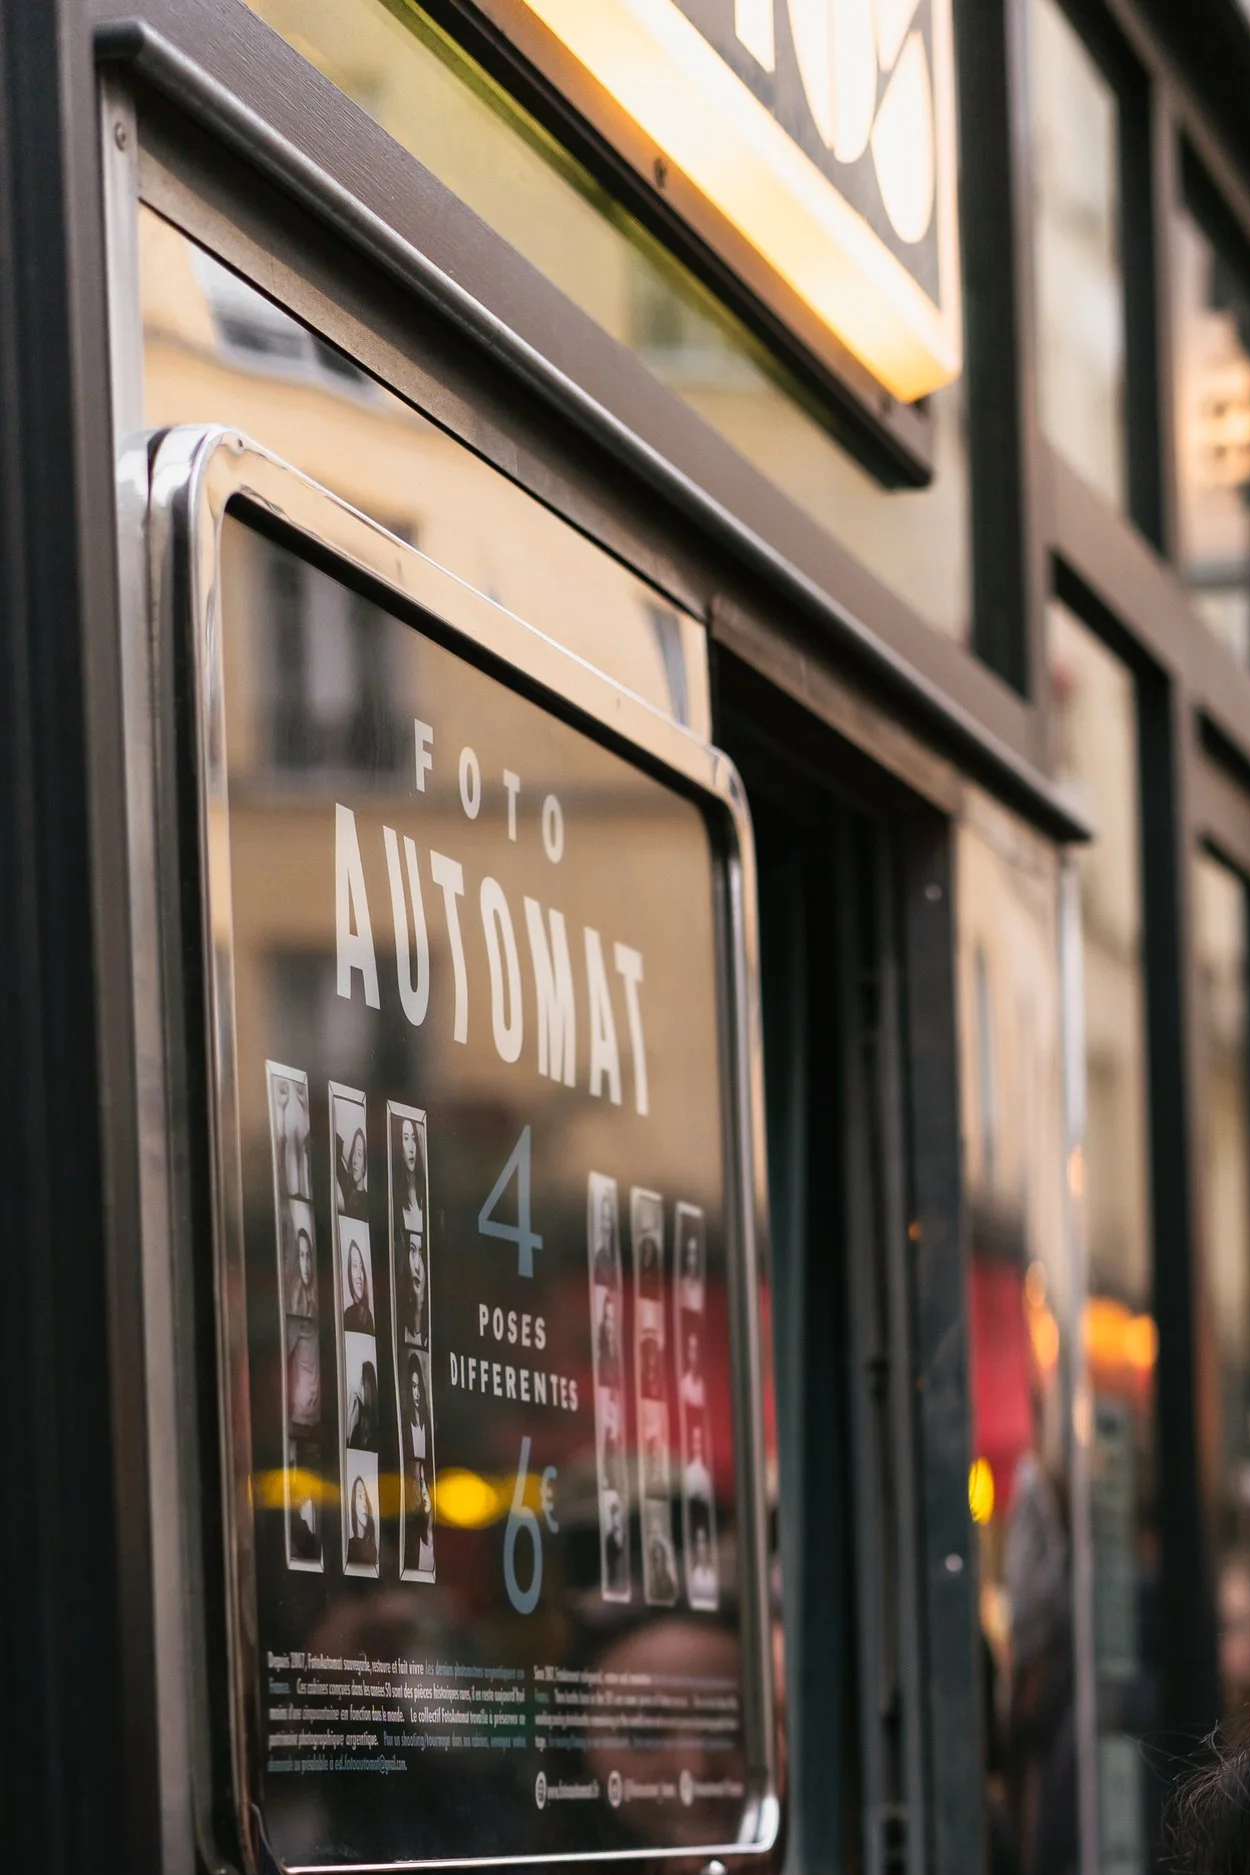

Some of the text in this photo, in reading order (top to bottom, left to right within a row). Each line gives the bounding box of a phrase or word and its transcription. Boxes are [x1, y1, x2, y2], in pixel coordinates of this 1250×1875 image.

[414, 718, 565, 863] FOTO
[335, 802, 649, 1117] AUTOMAT
[478, 1124, 544, 1278] 4
[479, 1303, 547, 1350] POSES
[450, 1351, 579, 1413] DIFFERENTES
[391, 1660, 398, 1674] et
[398, 1658, 408, 1675] fait
[409, 1660, 424, 1675] vivre
[403, 1682, 413, 1699] des
[413, 1683, 432, 1703] pièces
[410, 1707, 417, 1722] Le
[418, 1706, 441, 1723] collectif
